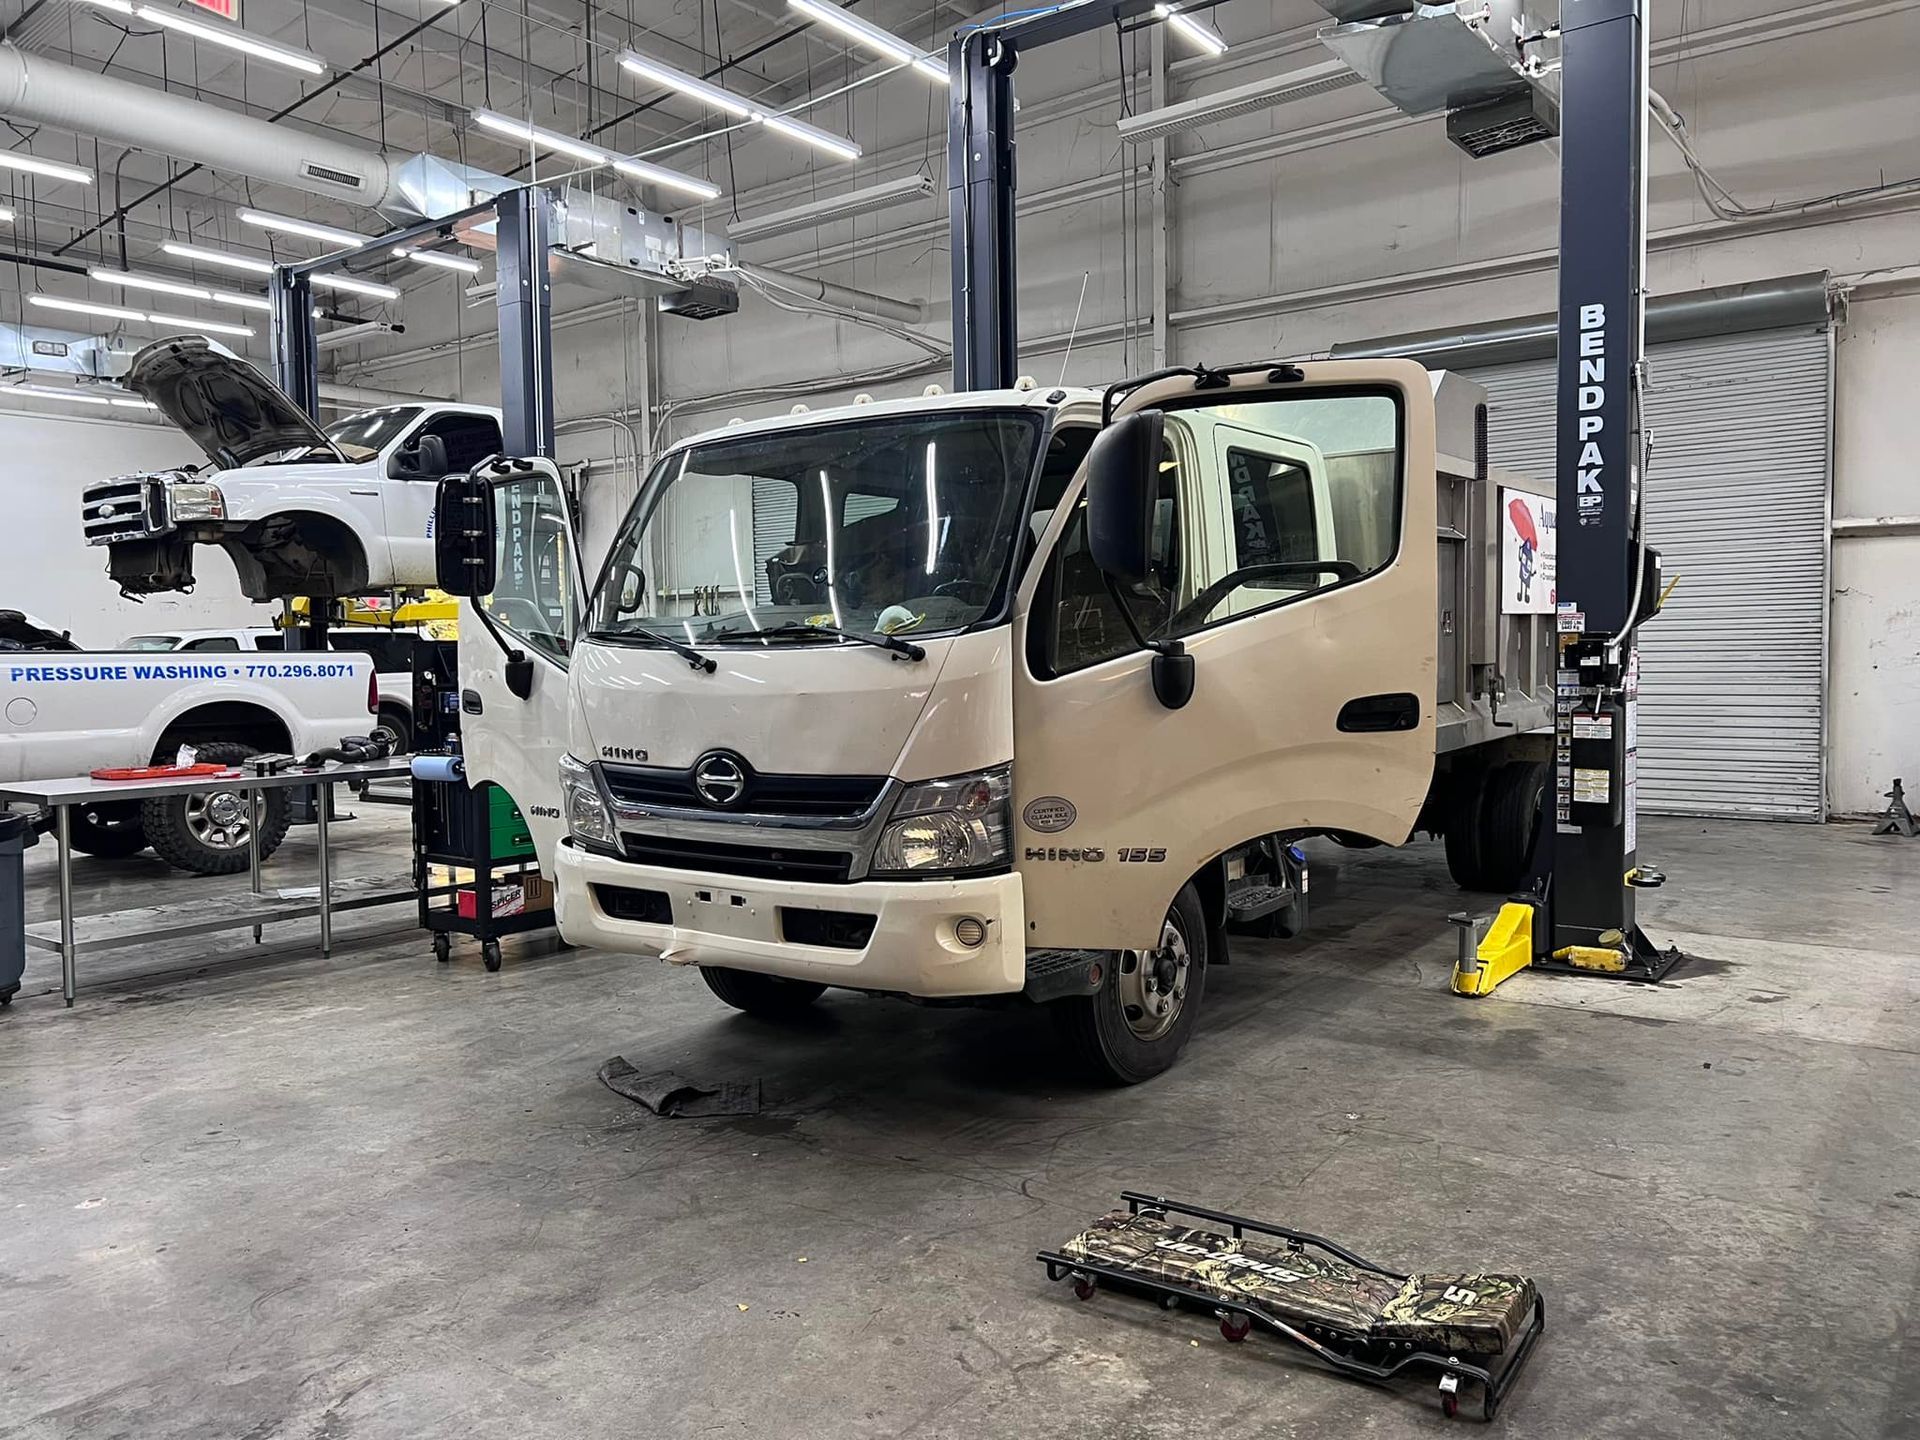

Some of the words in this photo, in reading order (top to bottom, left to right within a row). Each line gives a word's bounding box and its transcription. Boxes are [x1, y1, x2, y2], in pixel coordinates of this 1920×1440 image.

[1577, 303, 1606, 494] BENDPAK
[10, 666, 128, 682] PRESSURE
[133, 665, 228, 679] WASHING
[246, 664, 355, 678] 770.296.8071
[601, 745, 649, 762] HINO
[1025, 847, 1106, 863] HINO
[1117, 847, 1168, 863] 155
